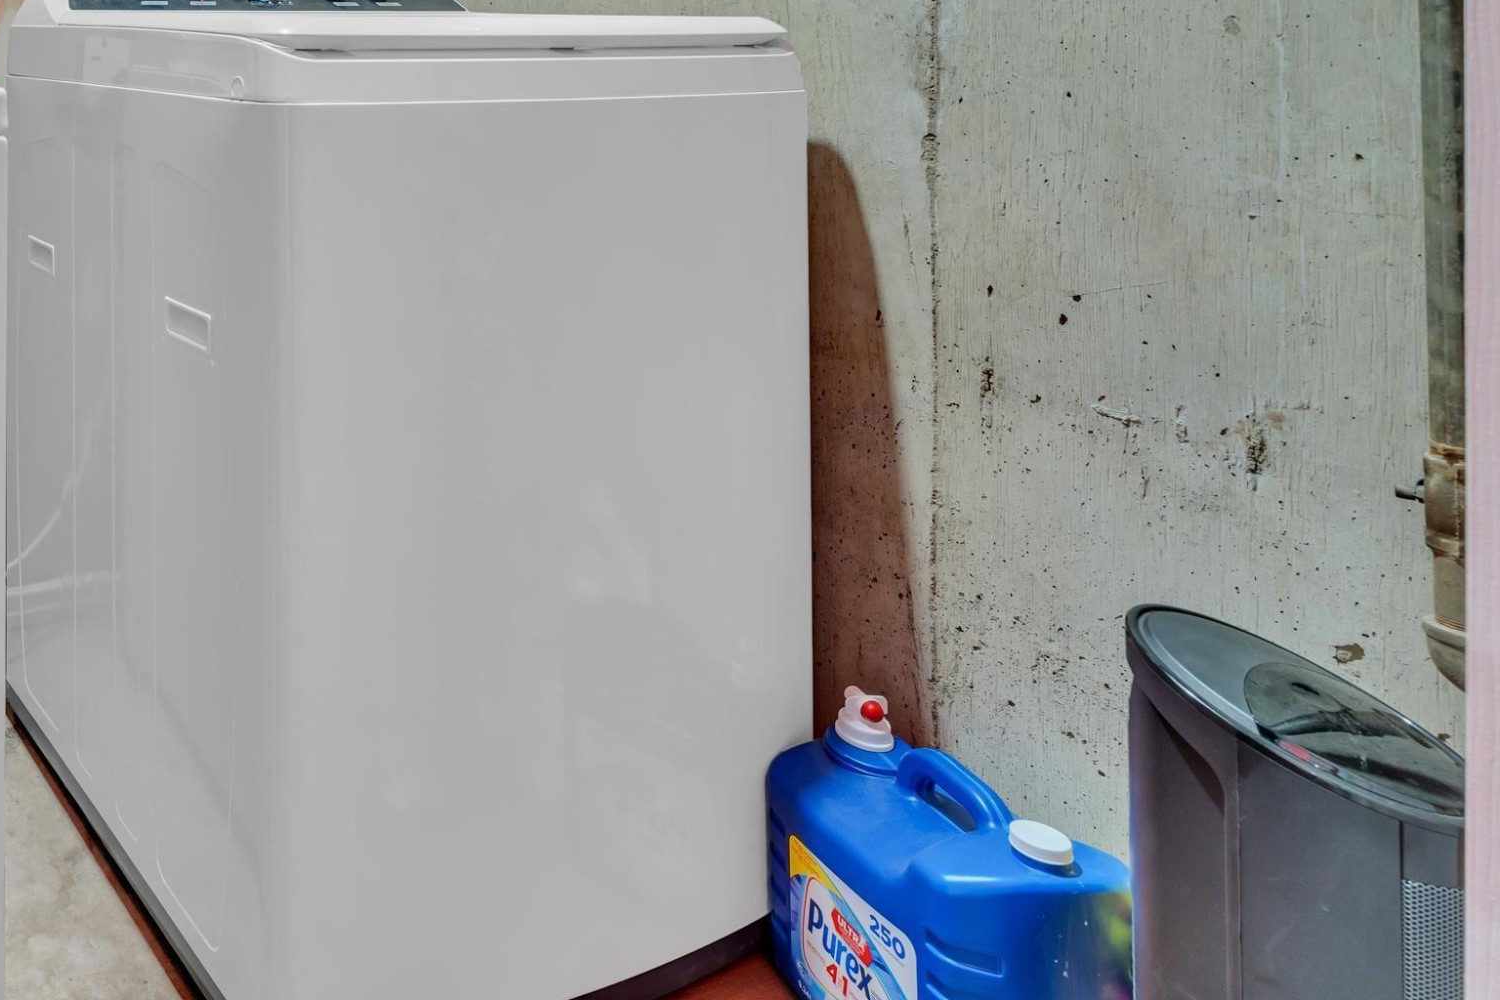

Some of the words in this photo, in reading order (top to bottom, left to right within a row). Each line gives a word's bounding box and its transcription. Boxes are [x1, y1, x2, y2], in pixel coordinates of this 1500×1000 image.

[808, 897, 872, 1000] Purex
[837, 913, 867, 954] ULTRA
[869, 914, 905, 959] 250
